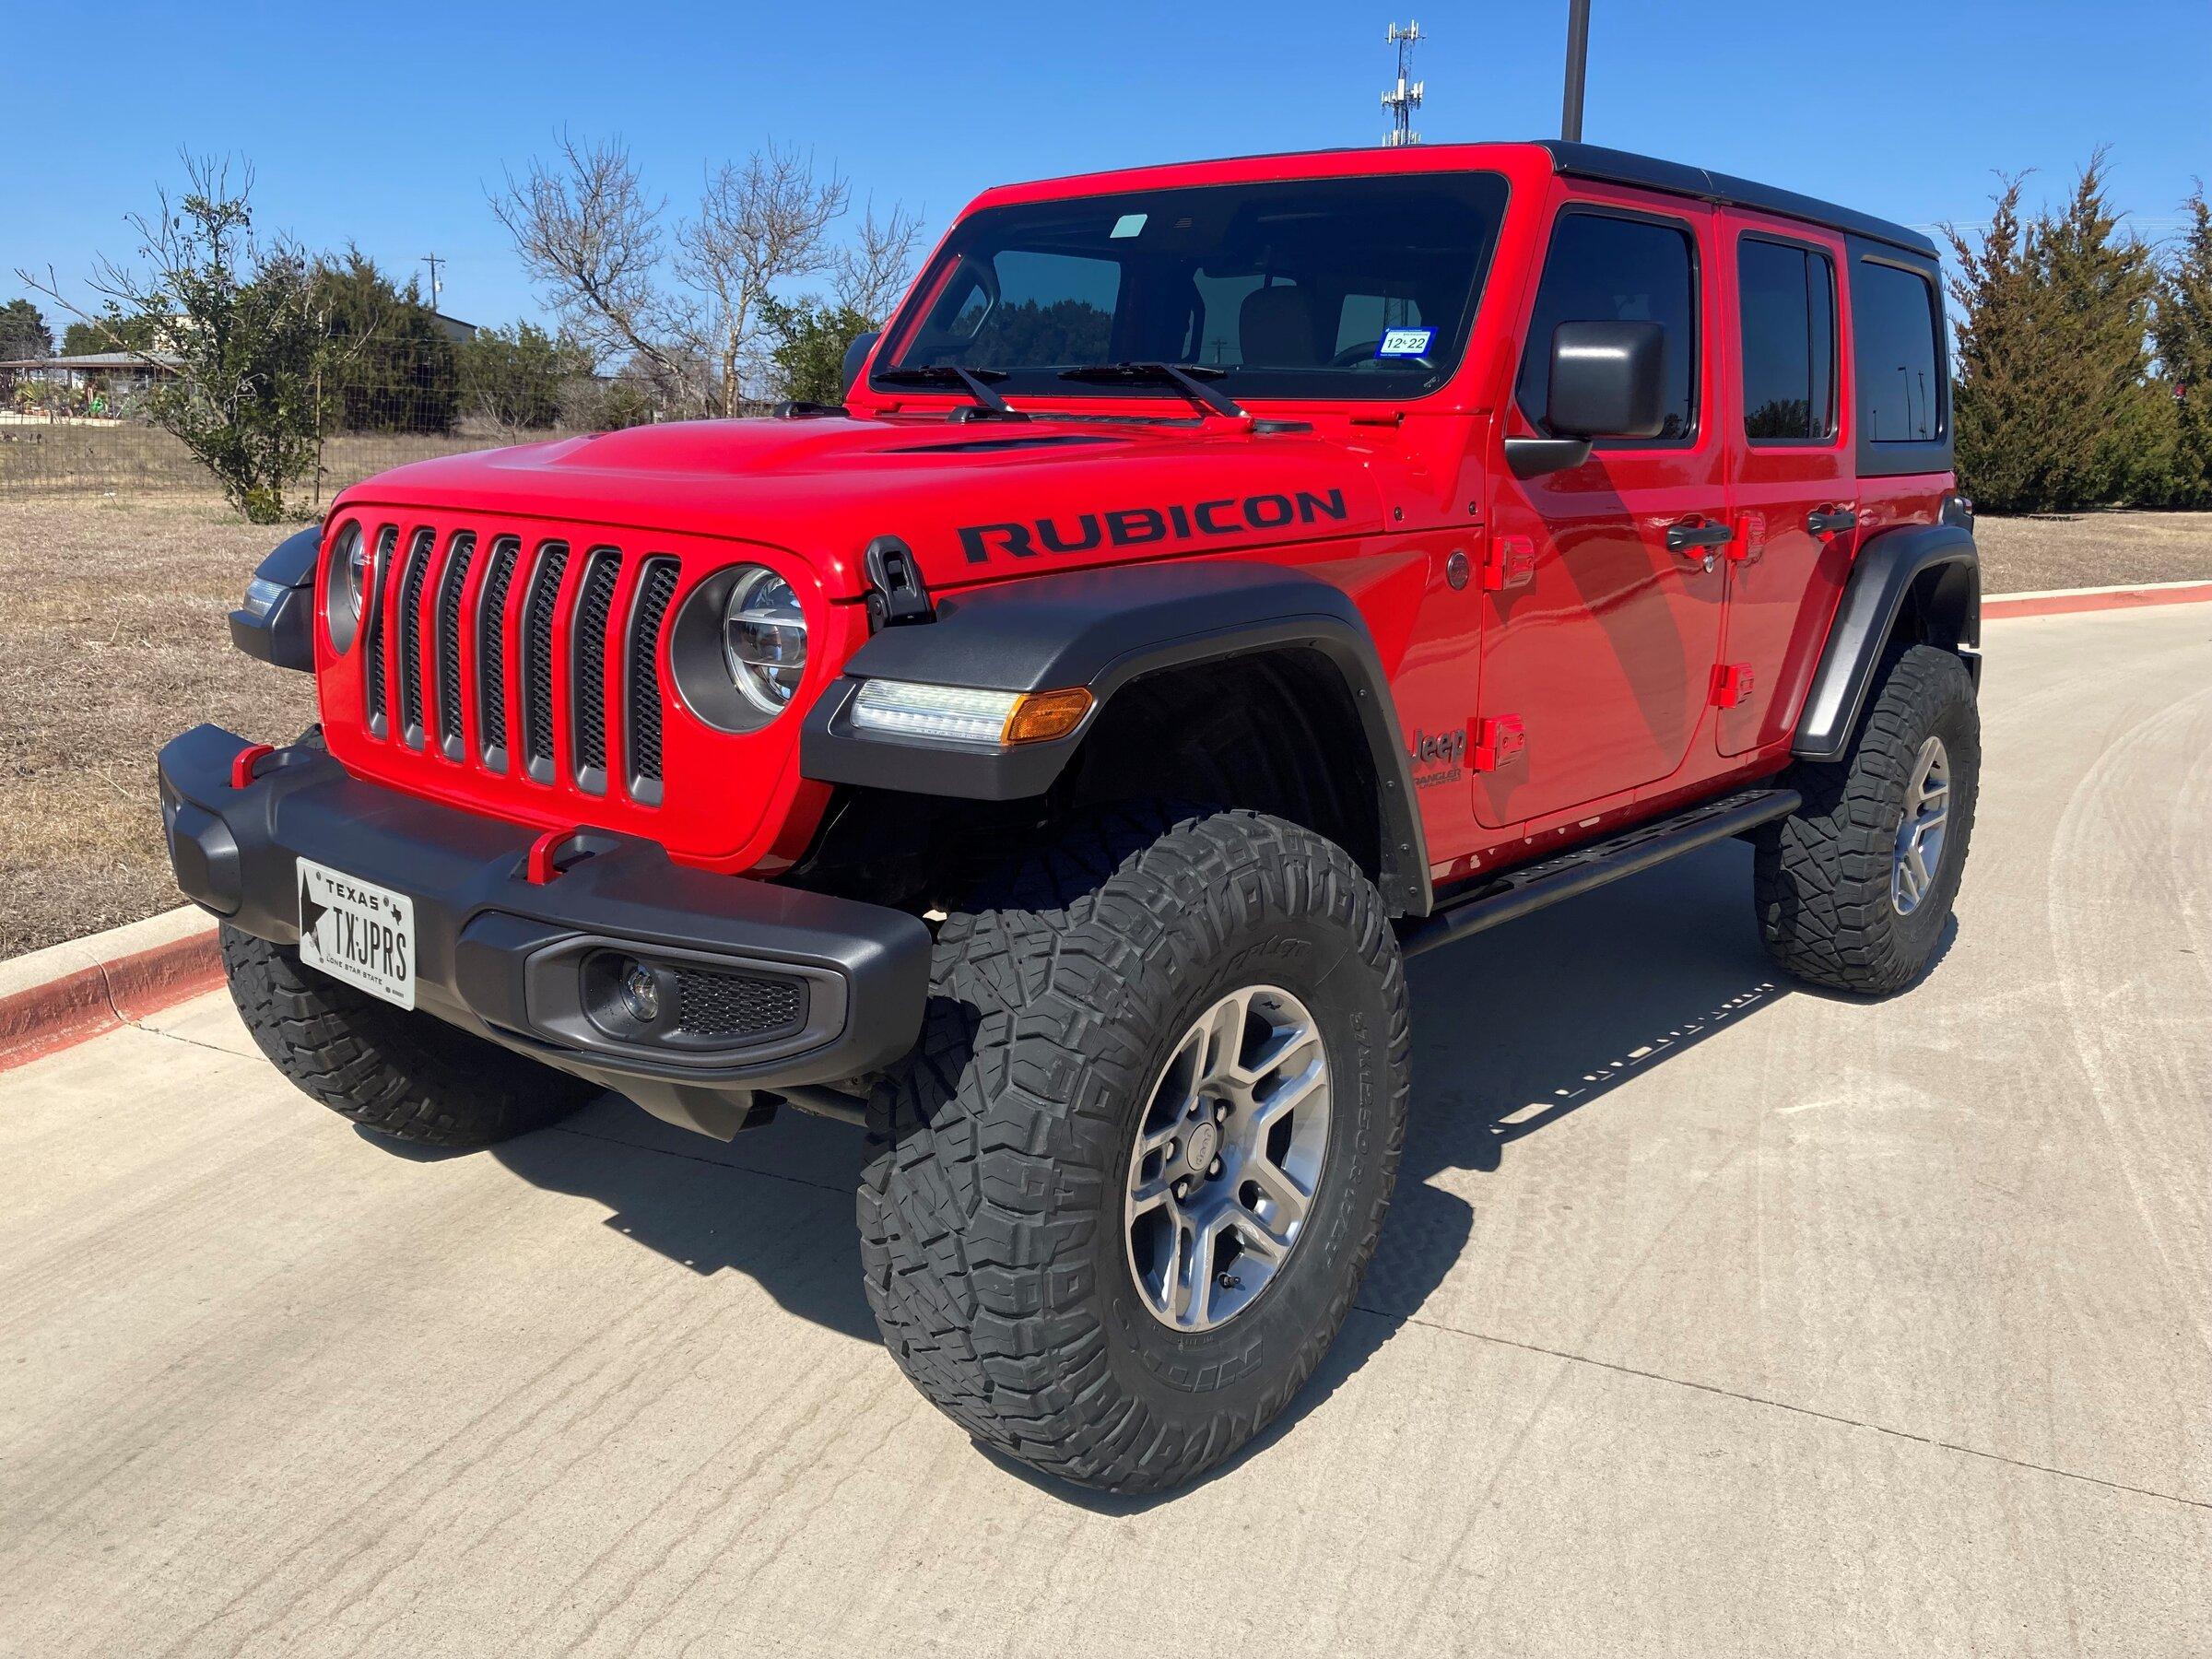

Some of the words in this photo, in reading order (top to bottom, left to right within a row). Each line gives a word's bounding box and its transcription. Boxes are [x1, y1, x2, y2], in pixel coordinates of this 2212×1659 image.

[956, 488, 1347, 565] RUBICON
[1408, 729, 1466, 767] Jeep
[325, 878, 379, 911] TEXAS
[326, 955, 343, 968] LONE
[345, 963, 360, 975] STAR
[363, 971, 382, 985] STATE
[1196, 1128, 1211, 1166] Jeep
